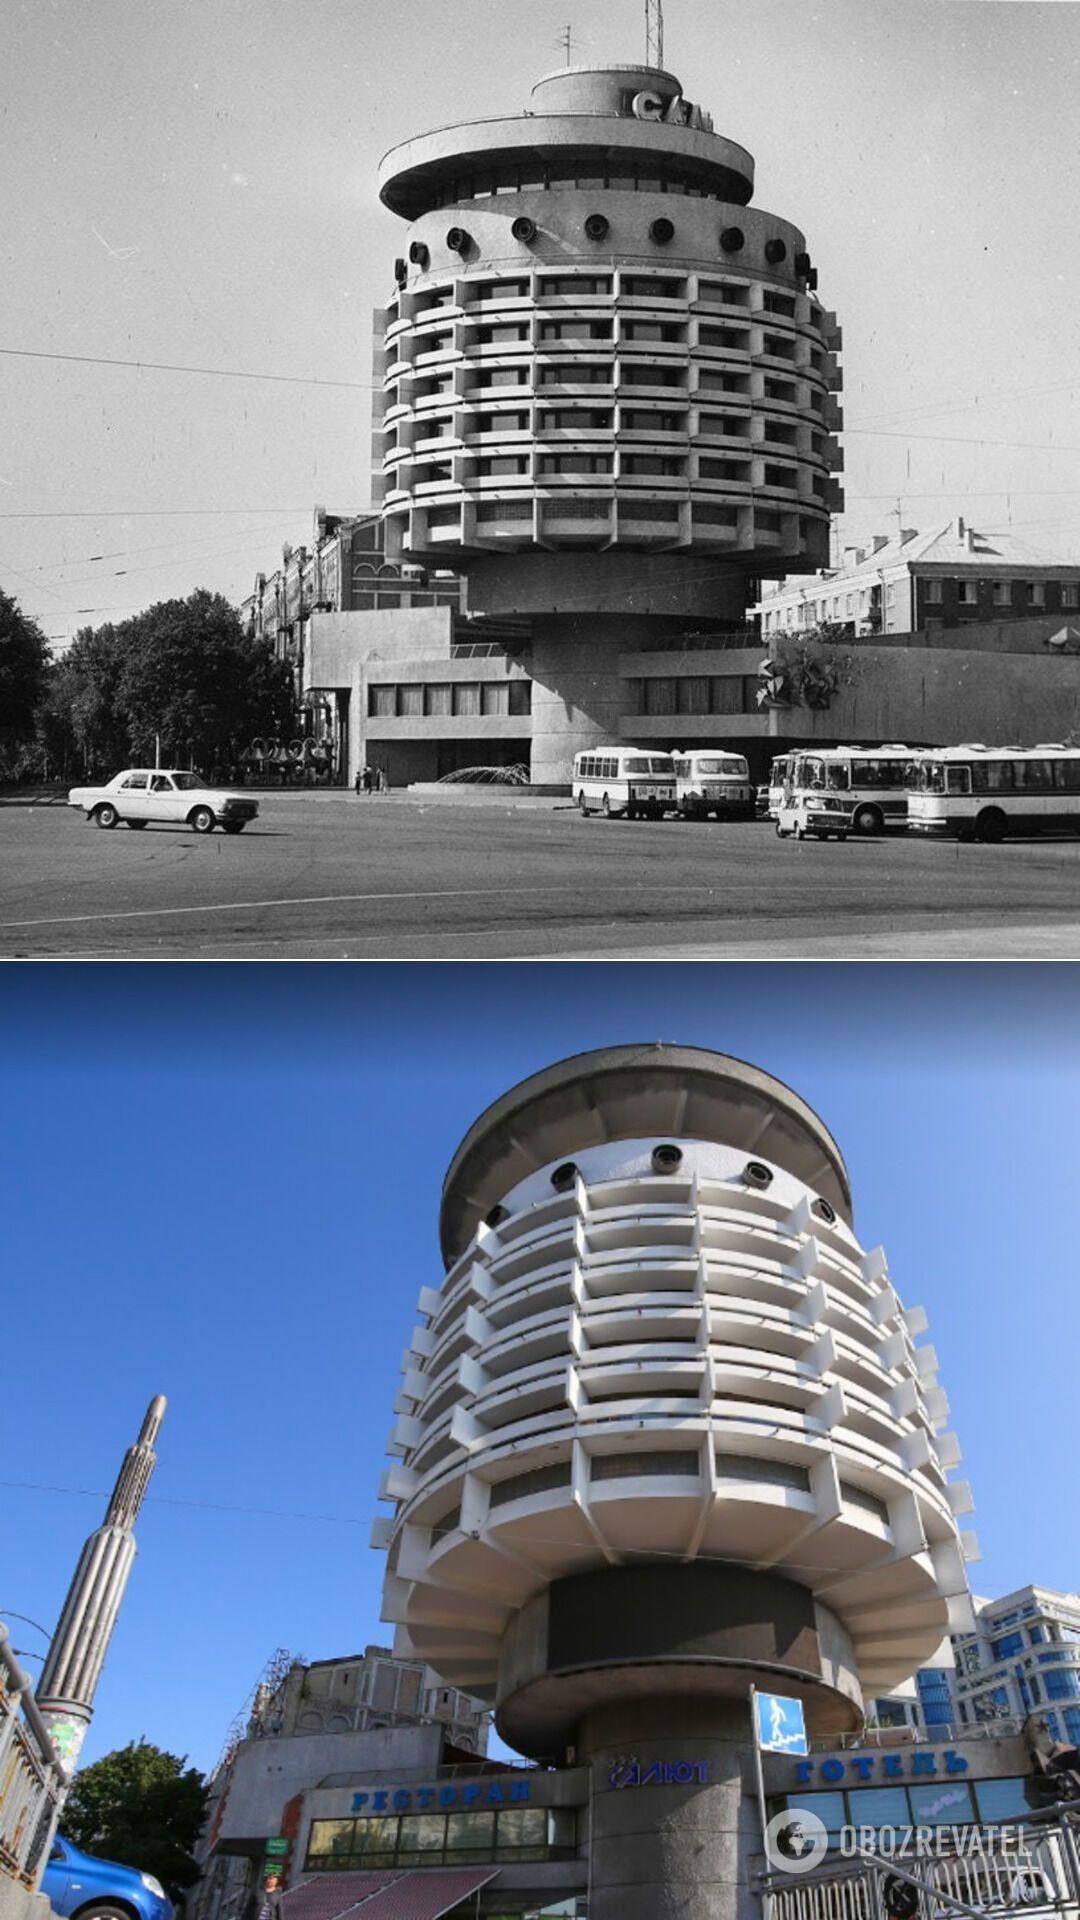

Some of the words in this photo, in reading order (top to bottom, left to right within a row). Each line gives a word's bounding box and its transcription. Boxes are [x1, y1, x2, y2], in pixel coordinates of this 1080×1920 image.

[608, 1758, 711, 1788] САЛЮТ
[796, 1750, 968, 1783] ГОТЕЛЬ
[352, 1780, 530, 1811] РЕСТОРАН
